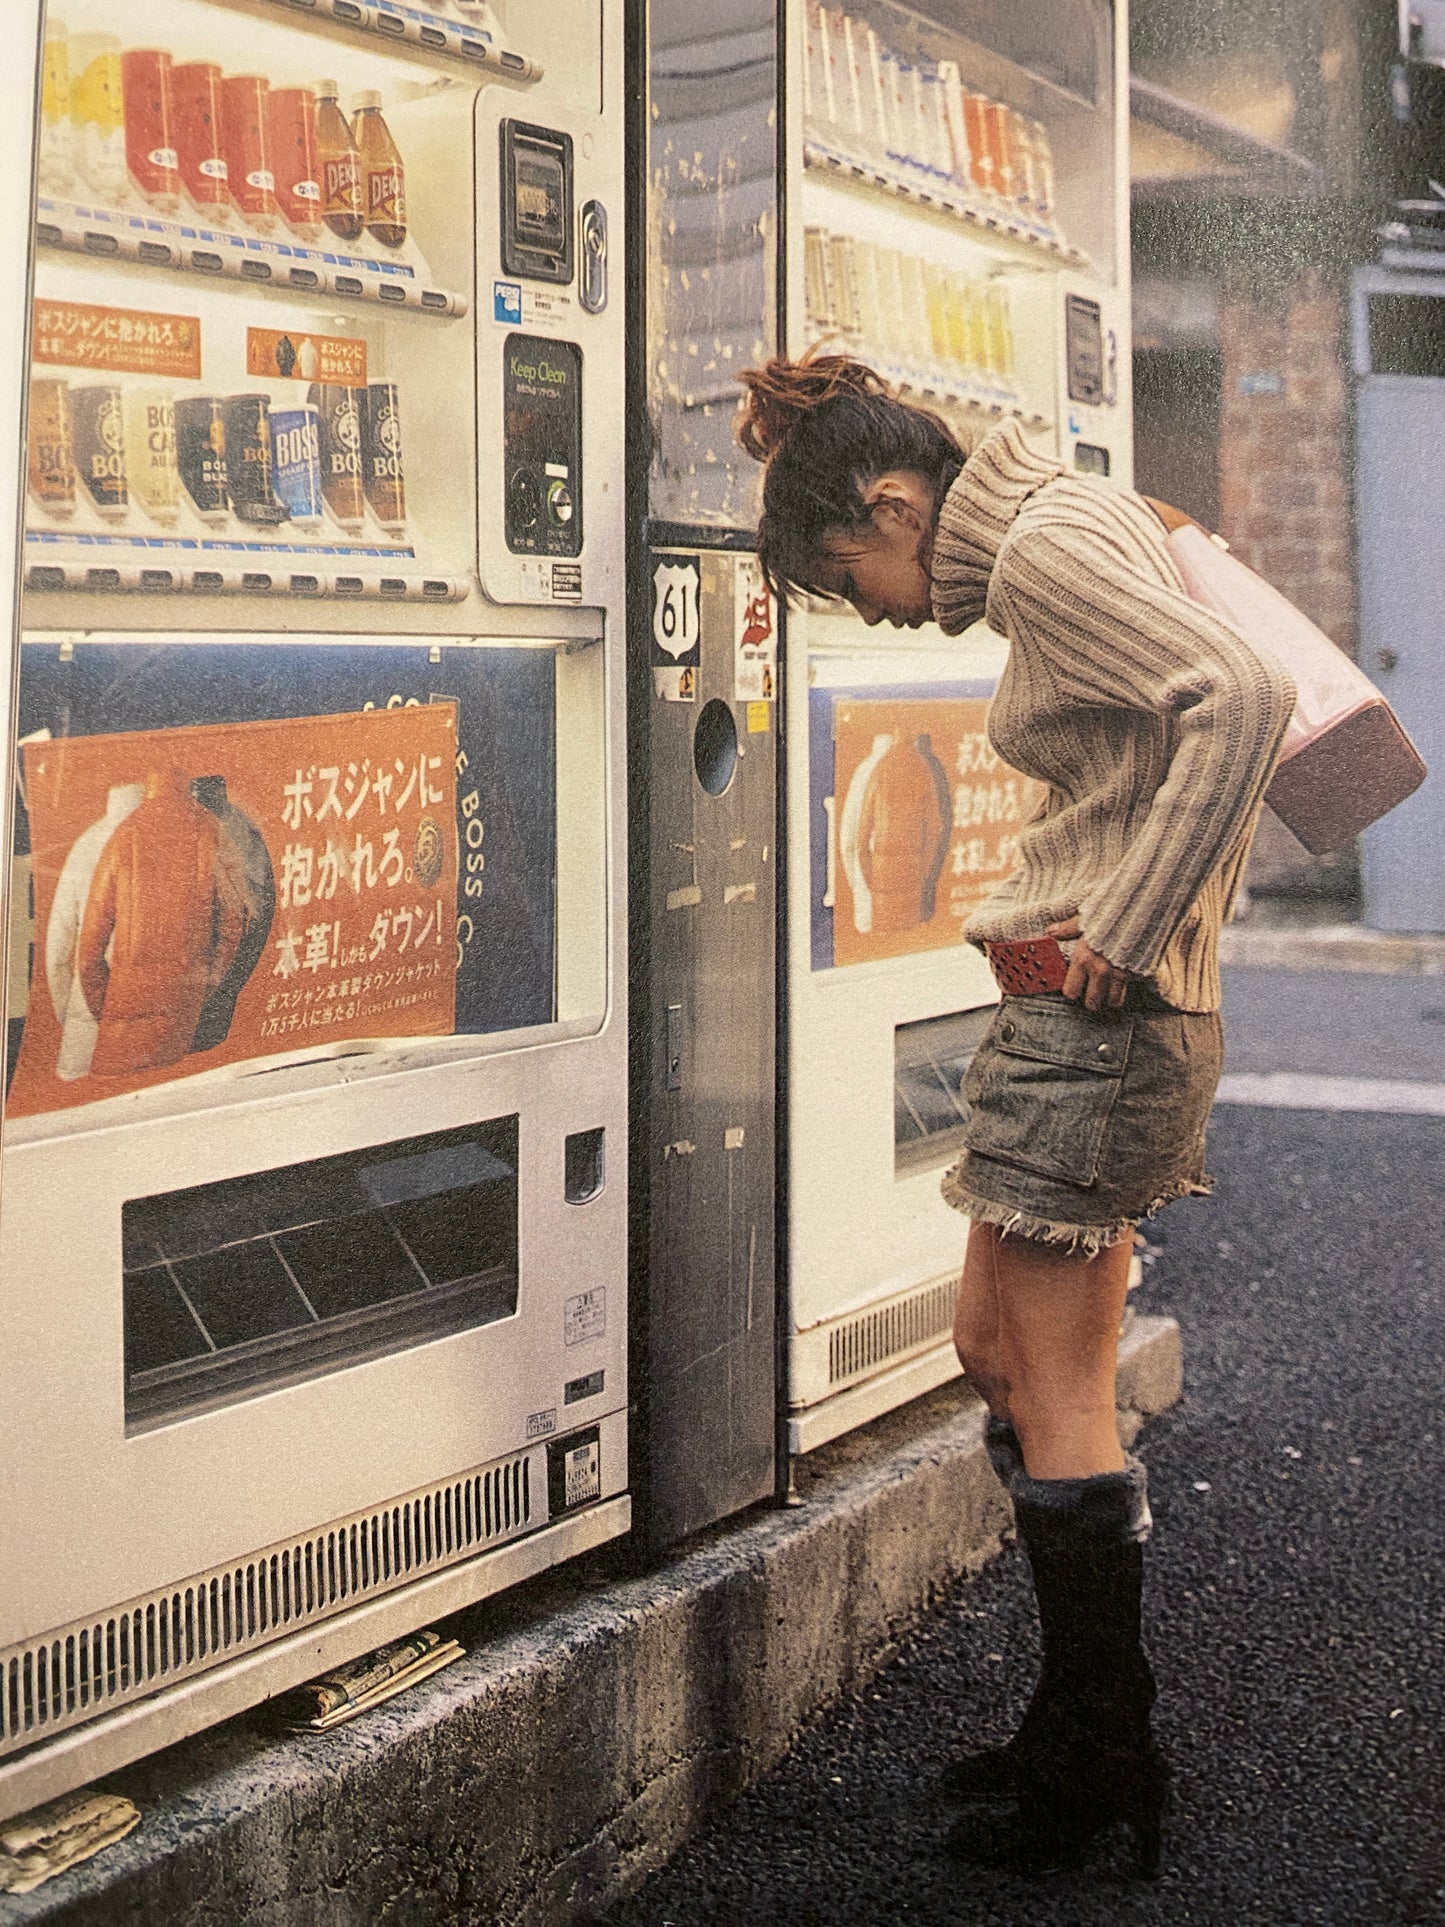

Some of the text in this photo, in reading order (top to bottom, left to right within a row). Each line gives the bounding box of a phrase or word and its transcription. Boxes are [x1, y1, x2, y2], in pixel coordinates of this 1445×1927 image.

[510, 357, 566, 384] Keep Clean
[276, 424, 319, 468] BOSS
[661, 584, 687, 638] 61
[281, 752, 444, 831] ボスジャンに
[279, 827, 413, 909] 抱かれろ。
[460, 789, 485, 898] BOSS
